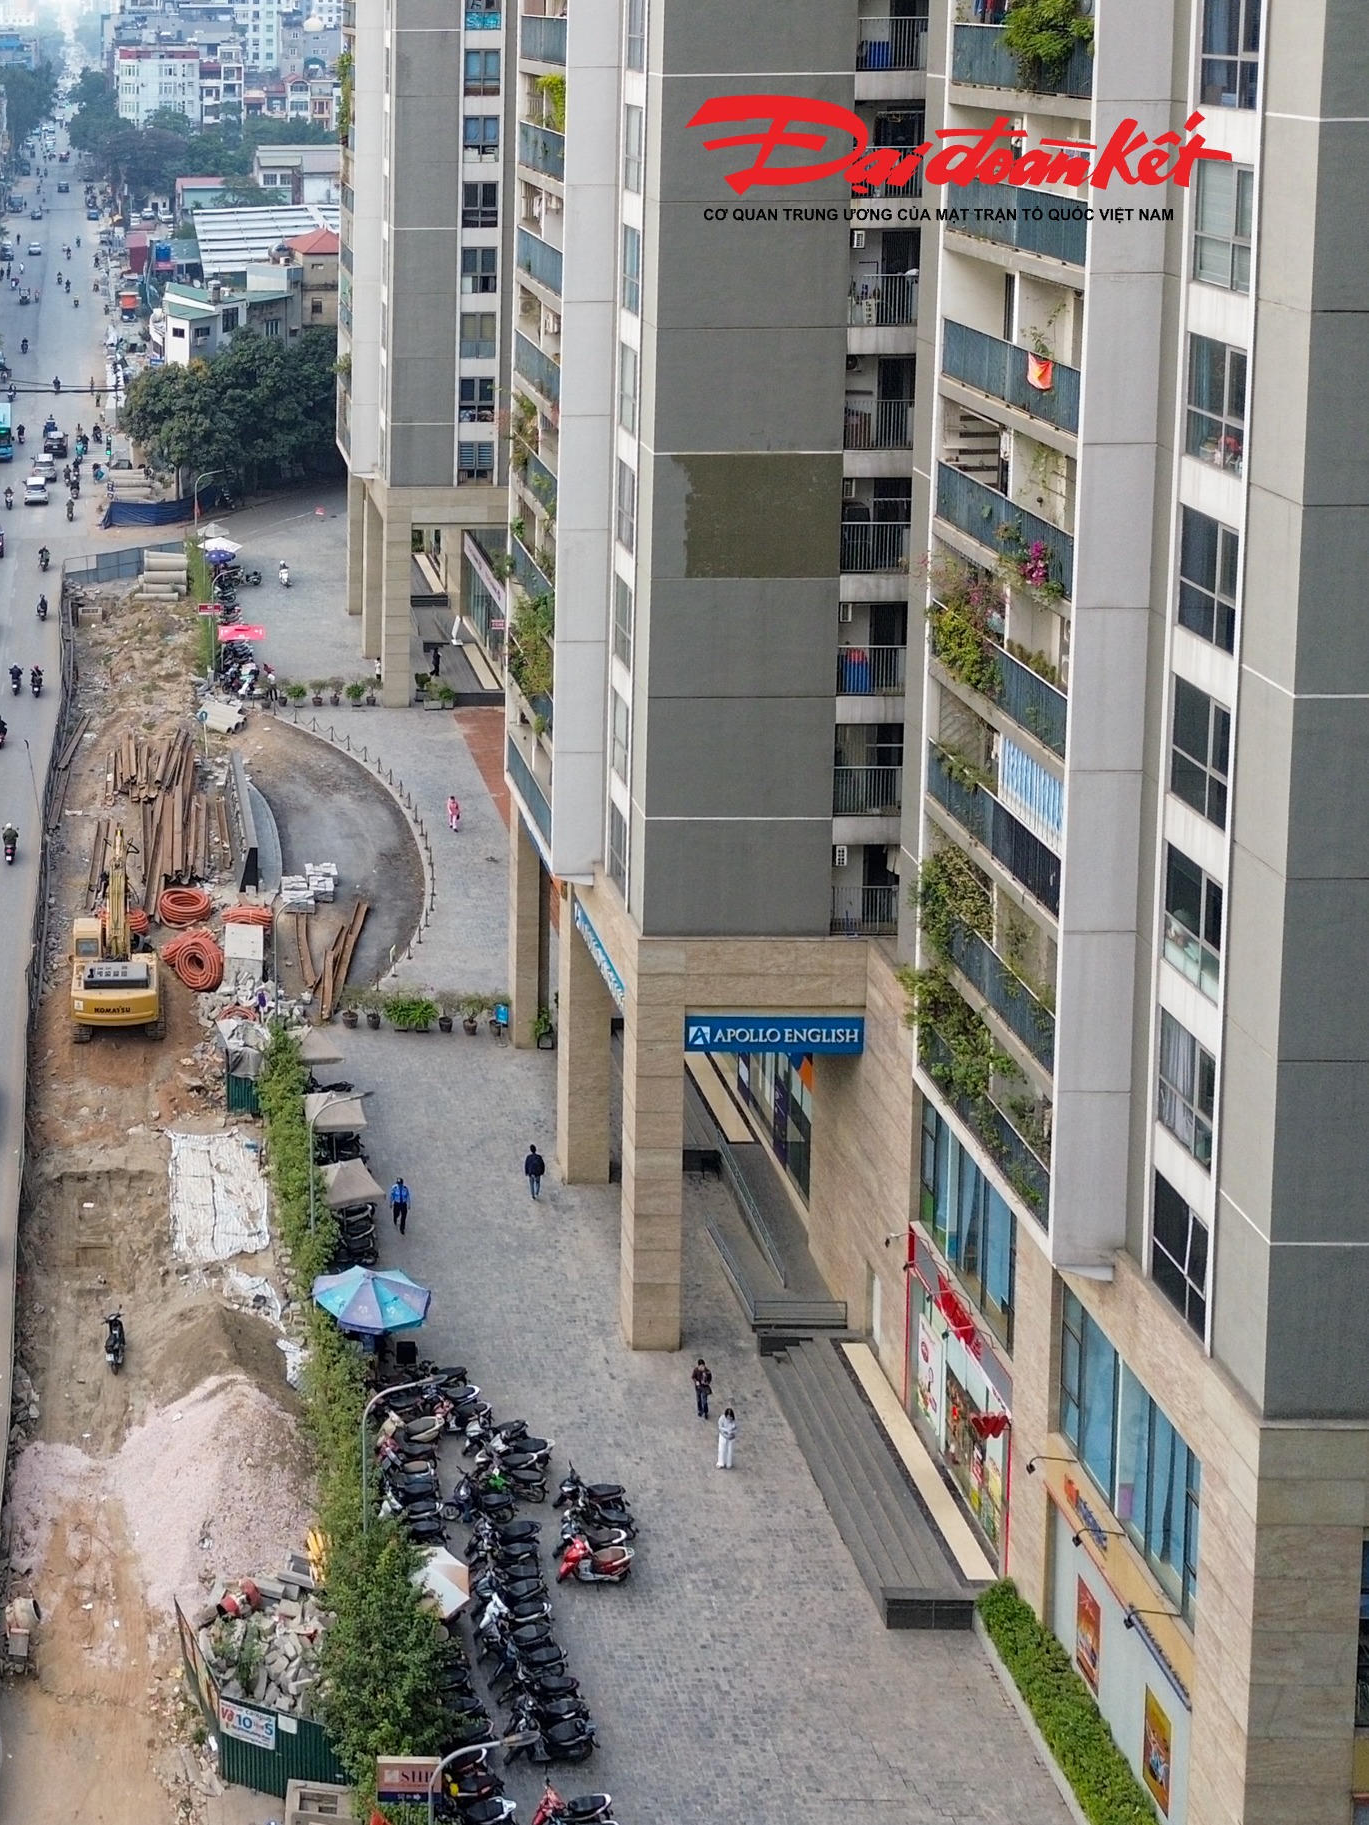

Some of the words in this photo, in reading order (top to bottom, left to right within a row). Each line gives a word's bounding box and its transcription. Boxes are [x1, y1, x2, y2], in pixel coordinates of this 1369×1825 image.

[94, 1006, 131, 1014] KOMATSU
[713, 1028, 780, 1043] APOLLO
[784, 1028, 859, 1043] ENGLISH
